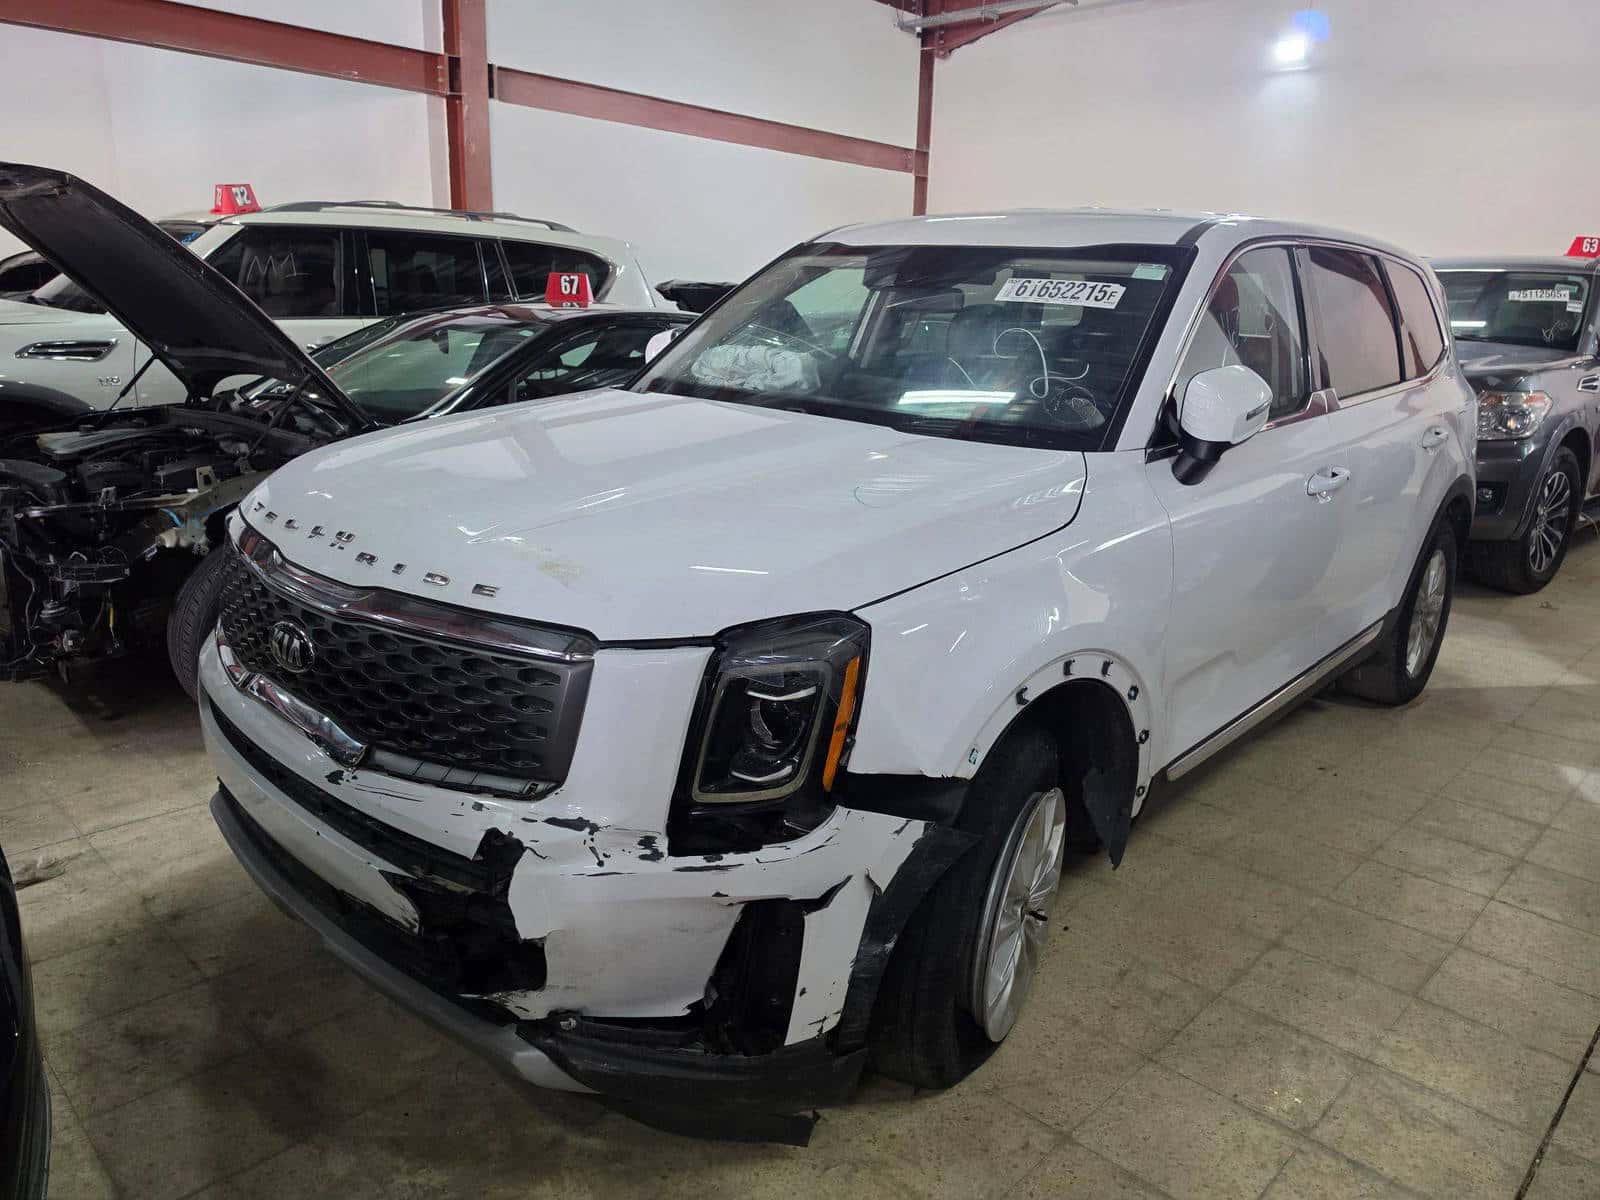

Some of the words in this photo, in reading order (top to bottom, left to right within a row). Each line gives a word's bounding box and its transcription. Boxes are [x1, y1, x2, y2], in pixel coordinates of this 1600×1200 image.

[1583, 239, 1599, 253] 63
[560, 275, 579, 295] 67
[254, 502, 500, 599] TELLURIDE
